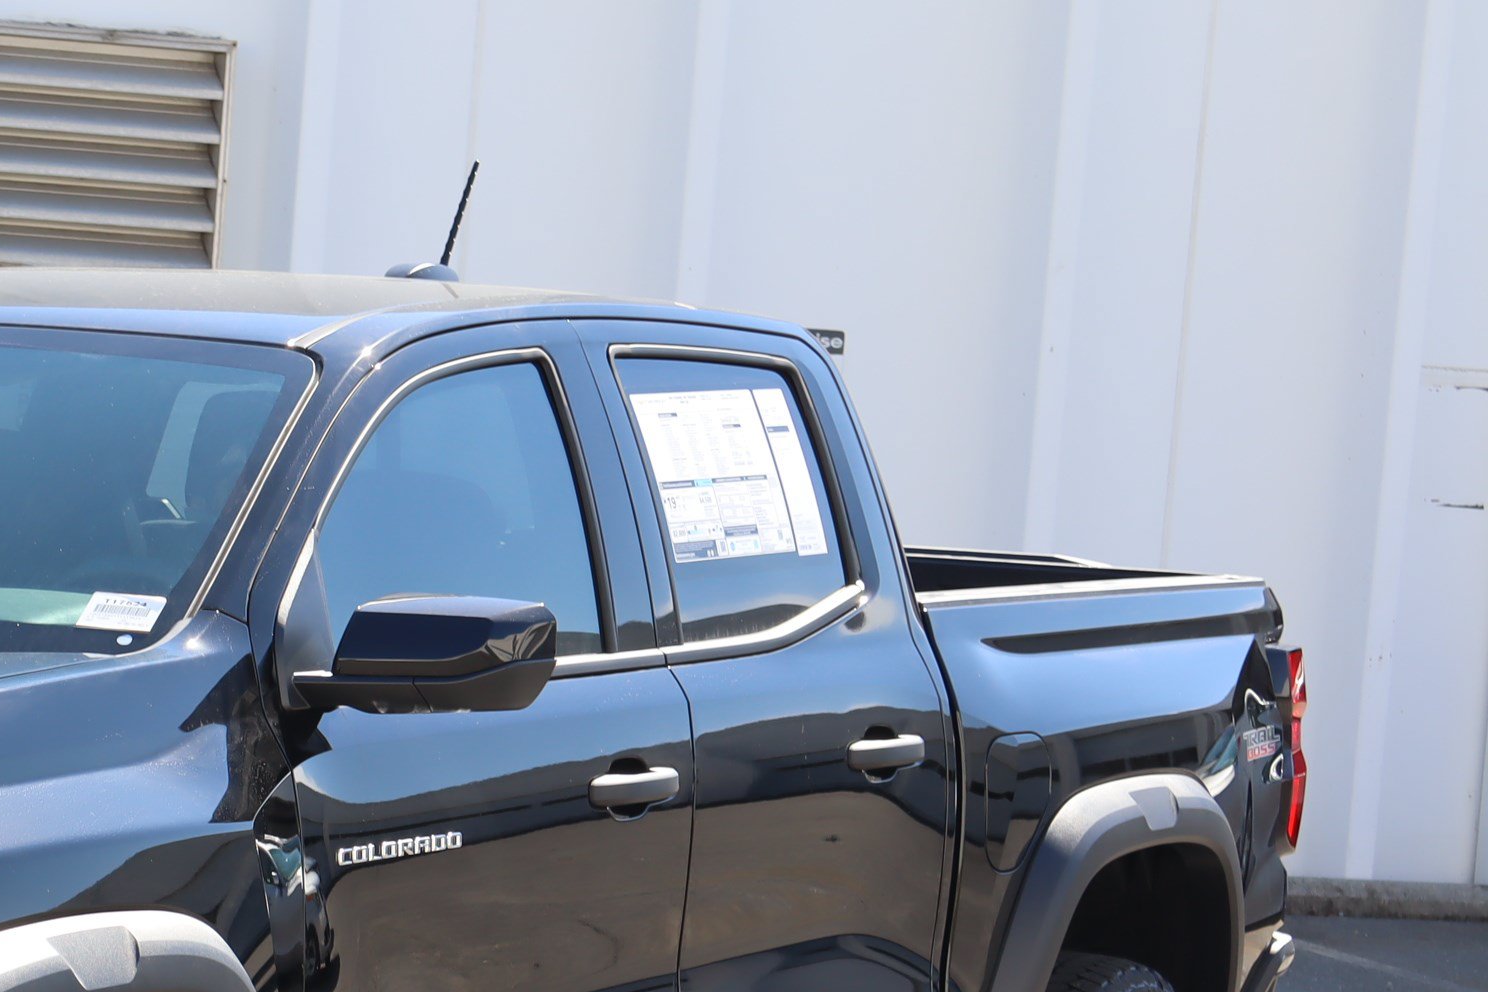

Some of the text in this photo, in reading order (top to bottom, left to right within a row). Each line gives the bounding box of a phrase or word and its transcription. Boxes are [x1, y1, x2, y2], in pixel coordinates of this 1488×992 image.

[1242, 724, 1281, 748] TRAIL
[1246, 741, 1277, 762] BOSS
[336, 830, 463, 867] COLORADO
